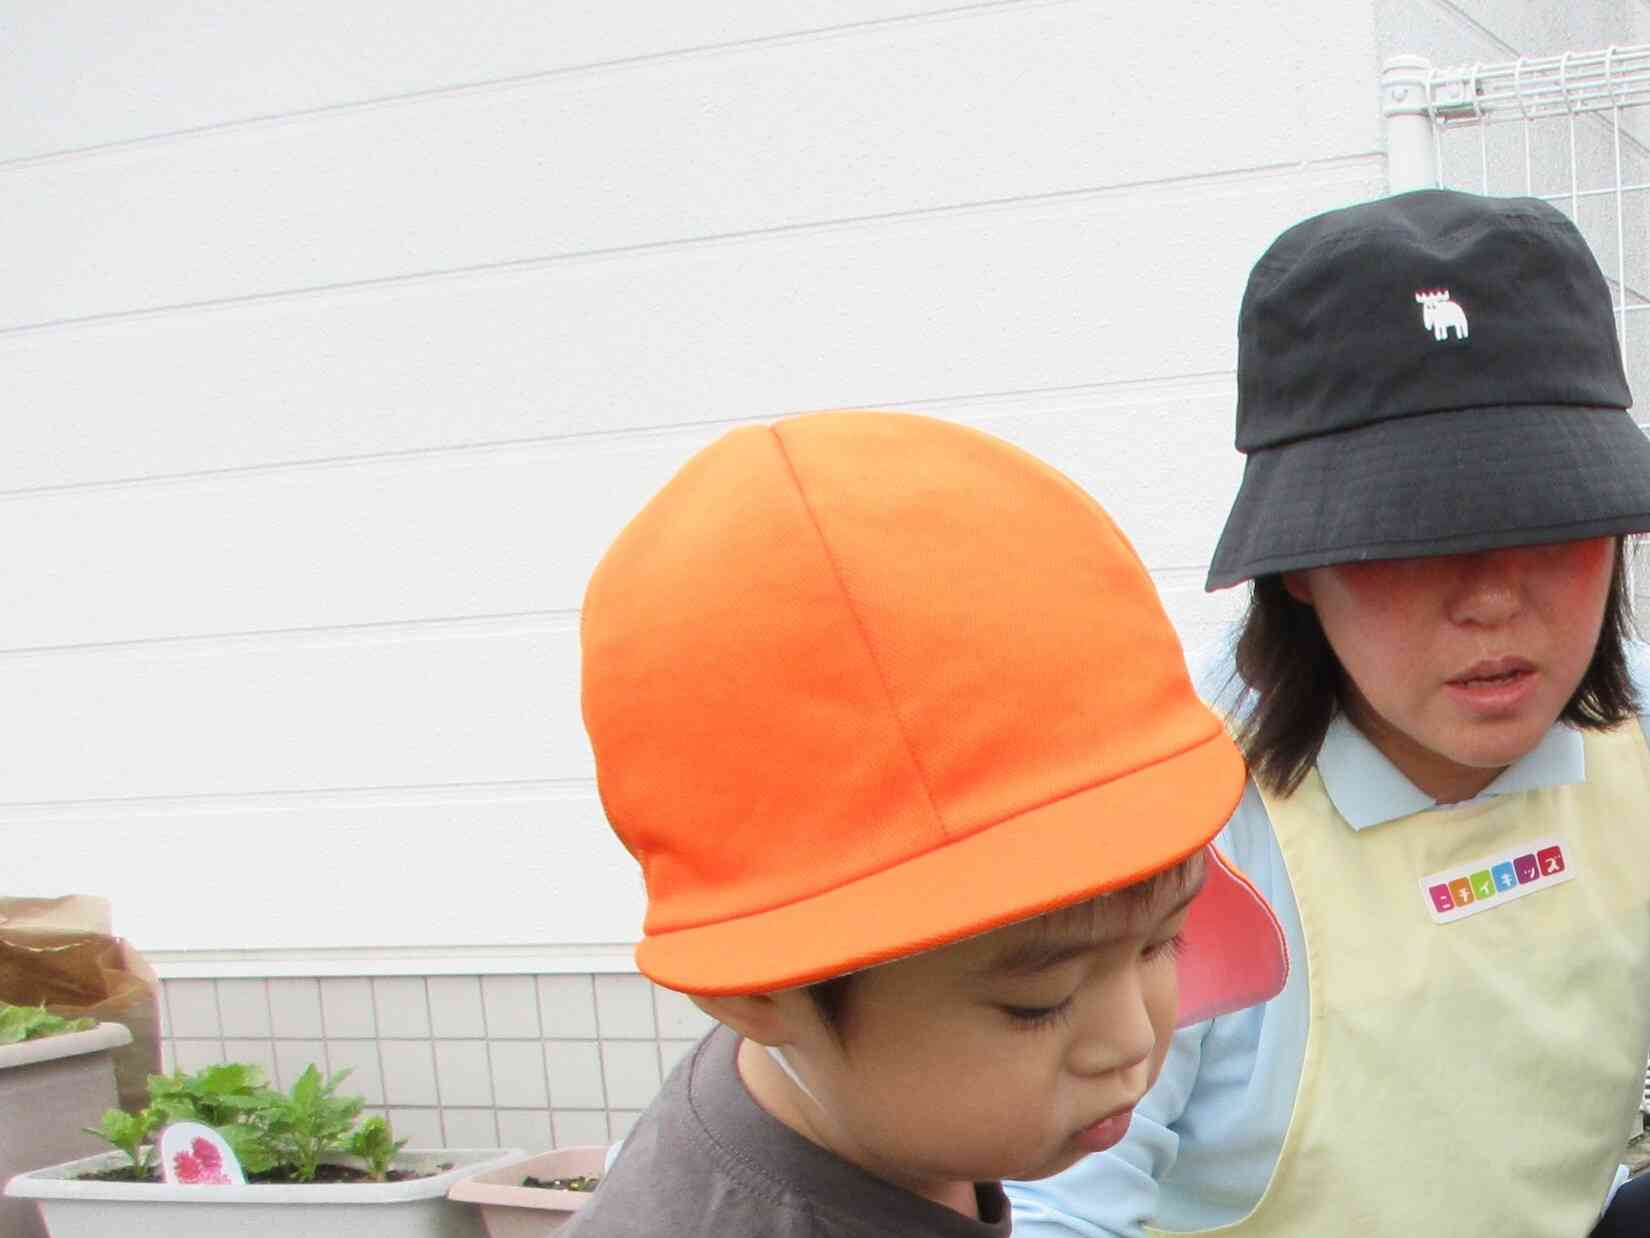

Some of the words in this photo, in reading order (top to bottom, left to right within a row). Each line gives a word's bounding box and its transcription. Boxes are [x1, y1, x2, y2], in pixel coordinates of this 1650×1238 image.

[1438, 852, 1562, 910] ニチイキッズ
